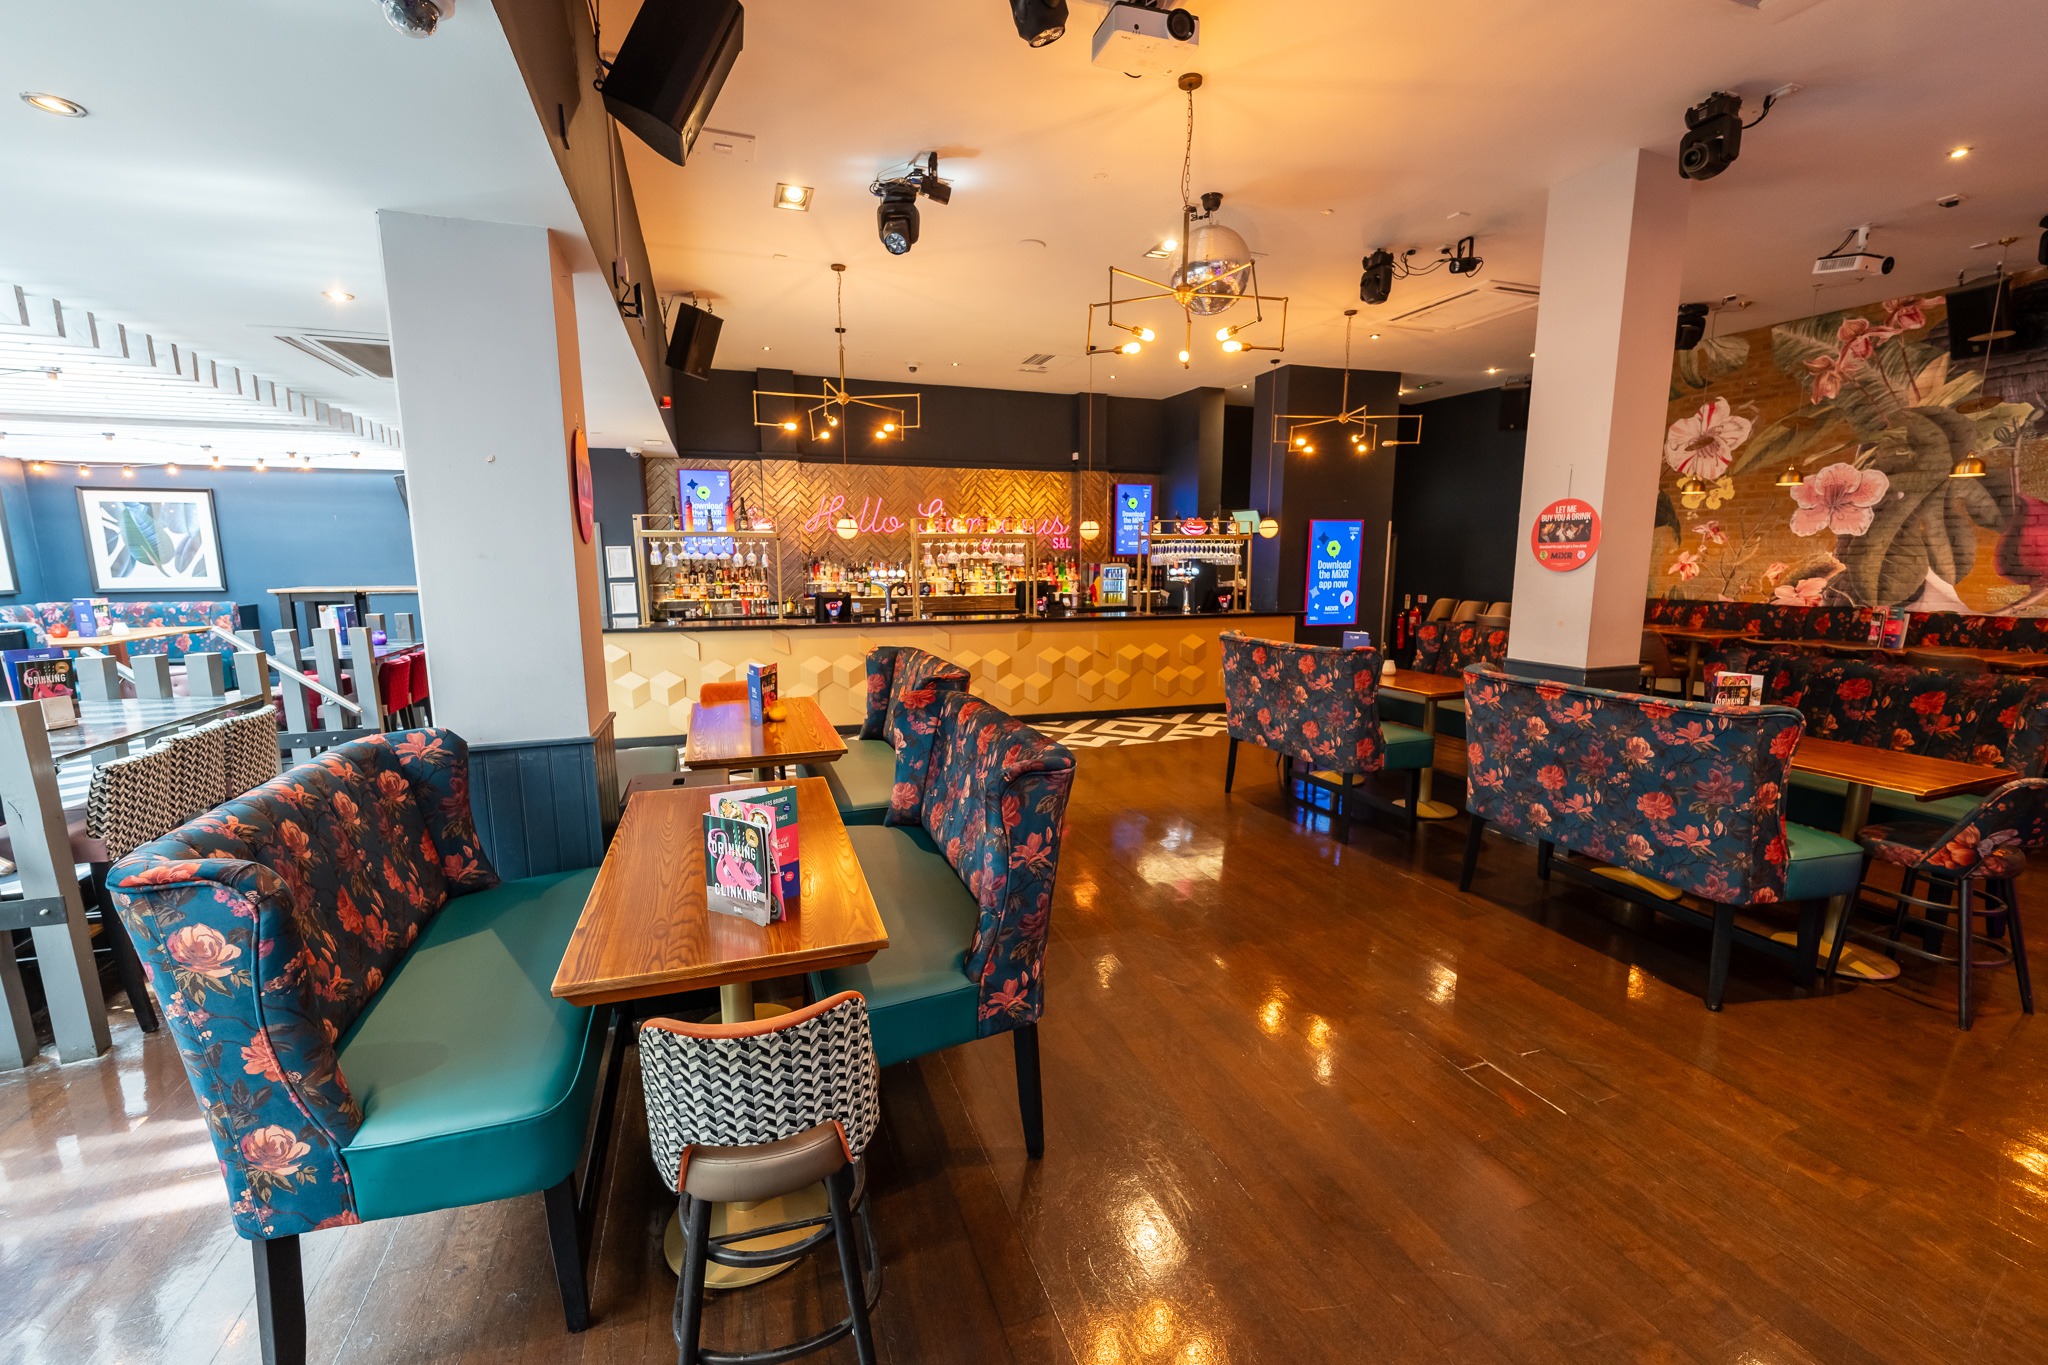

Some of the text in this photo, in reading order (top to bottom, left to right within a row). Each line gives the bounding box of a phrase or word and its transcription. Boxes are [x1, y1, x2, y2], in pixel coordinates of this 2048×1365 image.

[1555, 504, 1577, 514] LET ME
[1541, 511, 1592, 522] BUY YOU A DRINK
[803, 494, 1071, 551] Hllo Gorus
[1052, 537, 1072, 549] S&L
[1317, 560, 1351, 569] Download
[1319, 569, 1349, 579] the MiXR
[1318, 580, 1348, 590] app now
[28, 673, 66, 686] DRINKING
[712, 841, 757, 861] DRINKING
[714, 882, 758, 904] CLINKING
